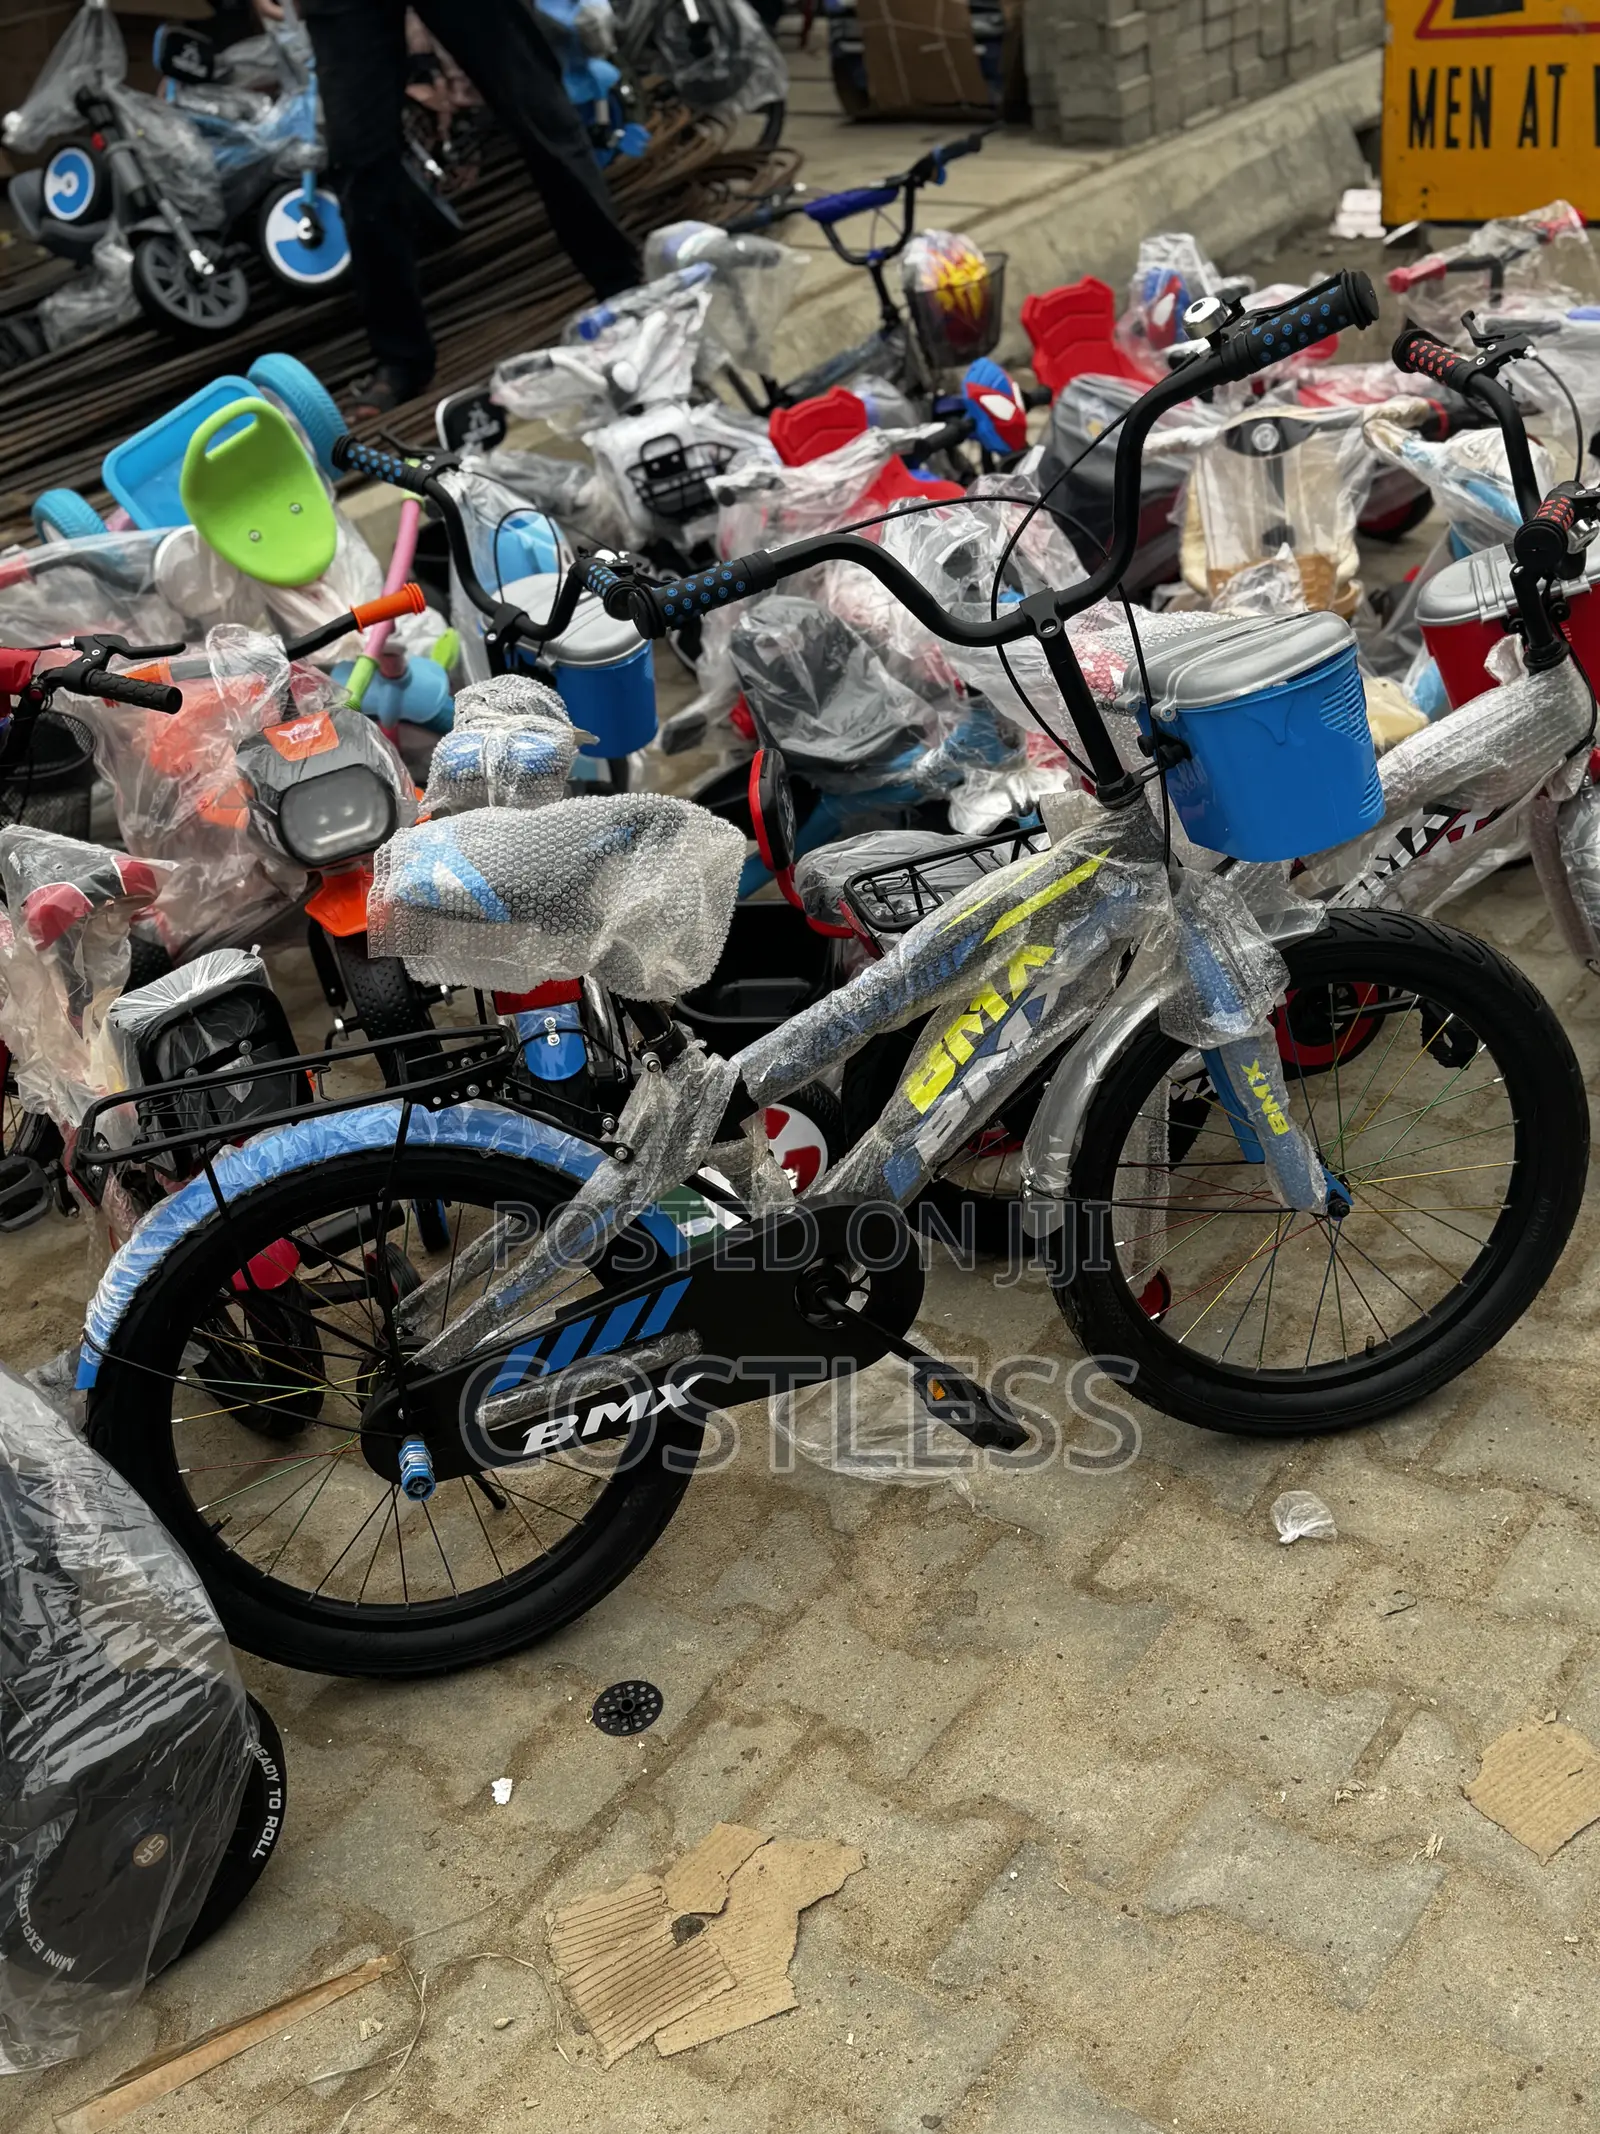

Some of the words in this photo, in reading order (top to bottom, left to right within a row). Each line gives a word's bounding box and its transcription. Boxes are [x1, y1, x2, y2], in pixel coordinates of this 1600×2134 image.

[1407, 64, 1494, 149] MEN
[1516, 62, 1568, 148] AT
[906, 944, 1056, 1115] BMX
[1240, 1058, 1290, 1136] BMX
[522, 1373, 704, 1455] BMX
[252, 1815, 279, 1858] ROLL
[268, 1788, 282, 1809] TO
[135, 1835, 165, 1864] SR
[19, 1867, 45, 1954] EXPLORER
[42, 1948, 76, 1972] MINI
